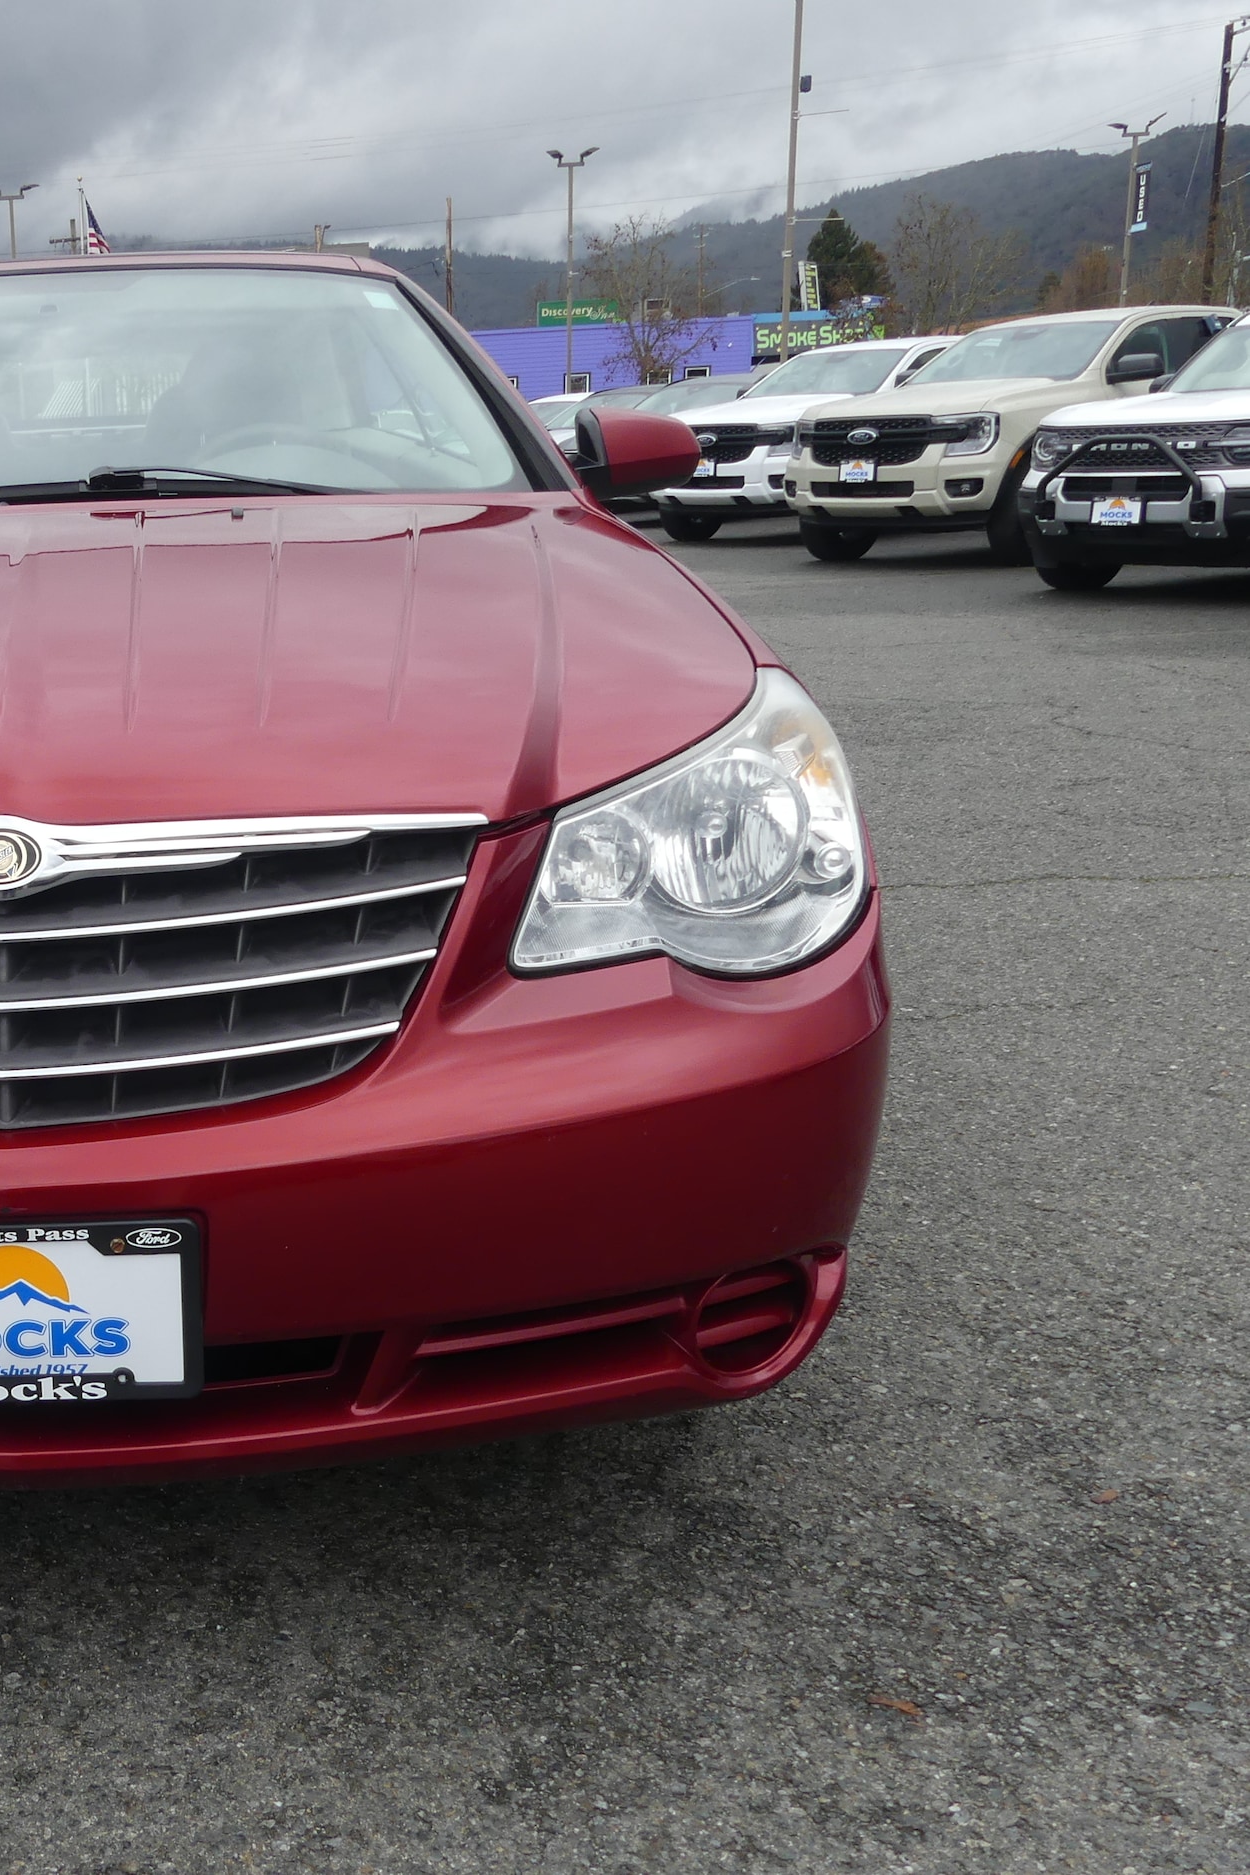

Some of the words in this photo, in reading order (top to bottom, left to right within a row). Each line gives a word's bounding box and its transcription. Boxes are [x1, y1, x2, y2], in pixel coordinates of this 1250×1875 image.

[1136, 174, 1147, 222] USED
[1100, 511, 1133, 519] MOCKS
[26, 1228, 90, 1242] Pass
[136, 1230, 170, 1244] Ford
[46, 1363, 89, 1375] 1957
